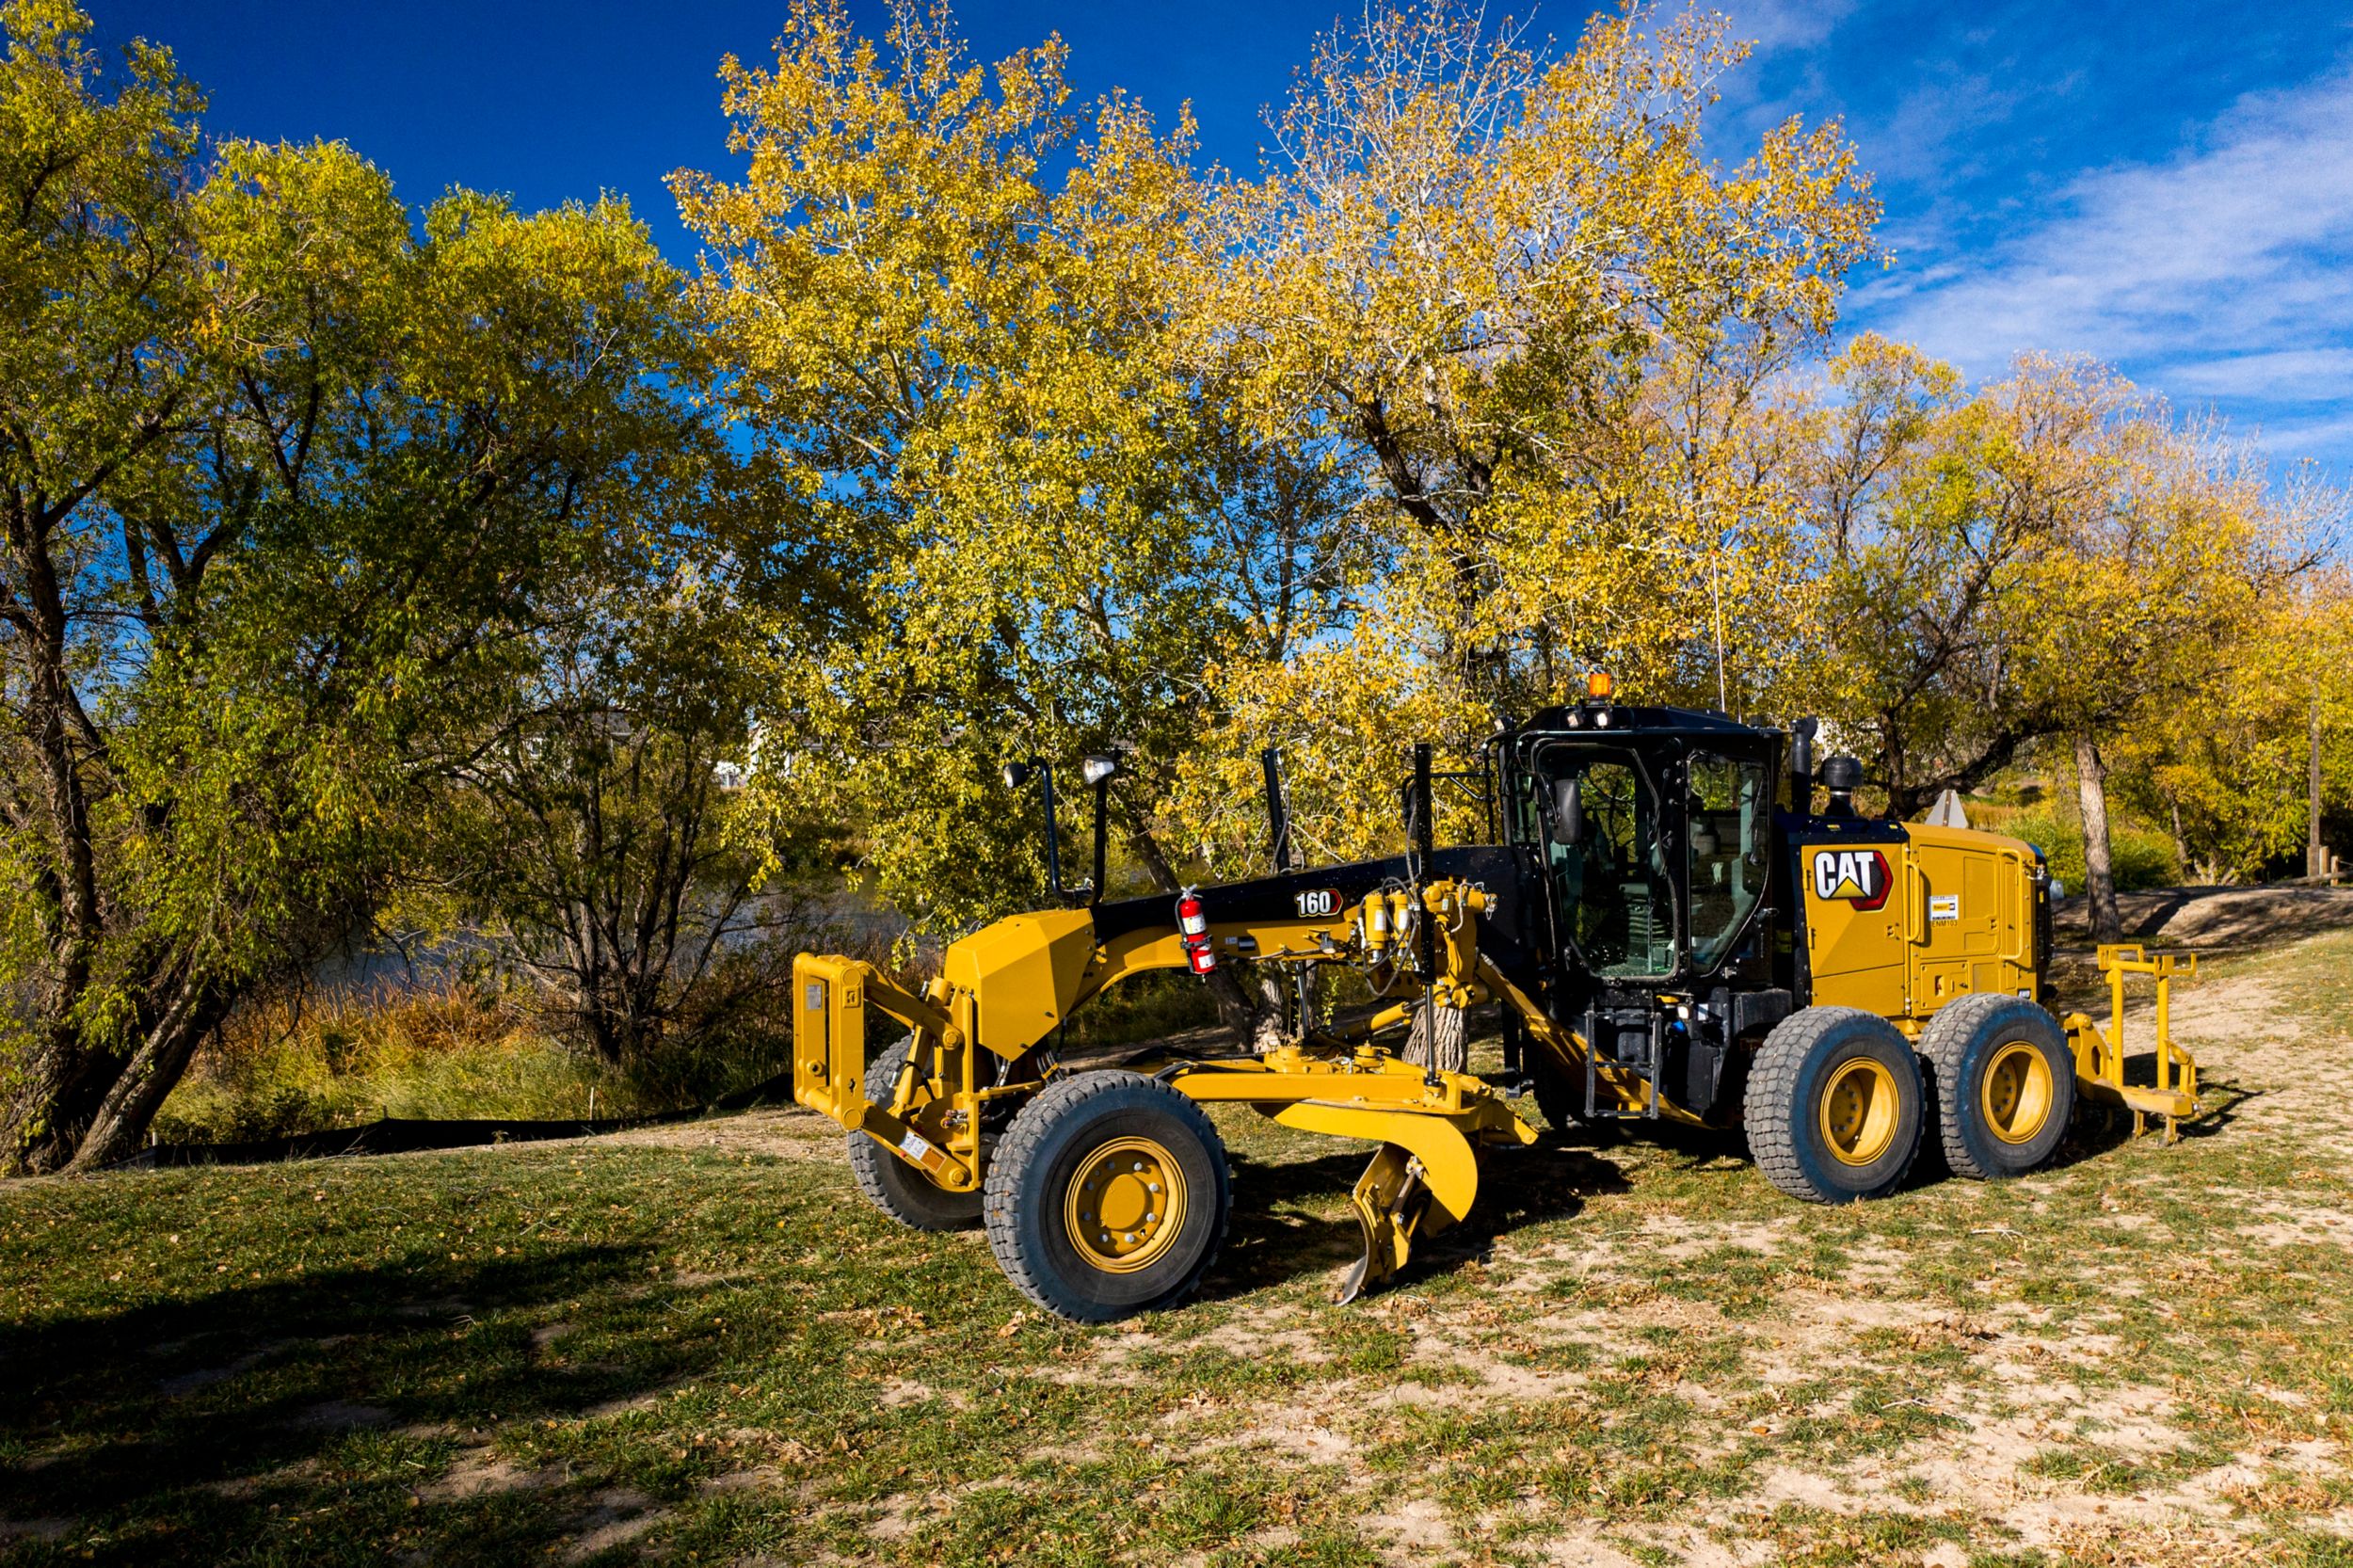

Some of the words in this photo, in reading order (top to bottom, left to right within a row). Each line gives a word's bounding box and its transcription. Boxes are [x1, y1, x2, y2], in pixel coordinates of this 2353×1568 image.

[1815, 852, 1874, 899] CAT
[1296, 890, 1331, 914] 160
[1931, 920, 1958, 928] ENM103
